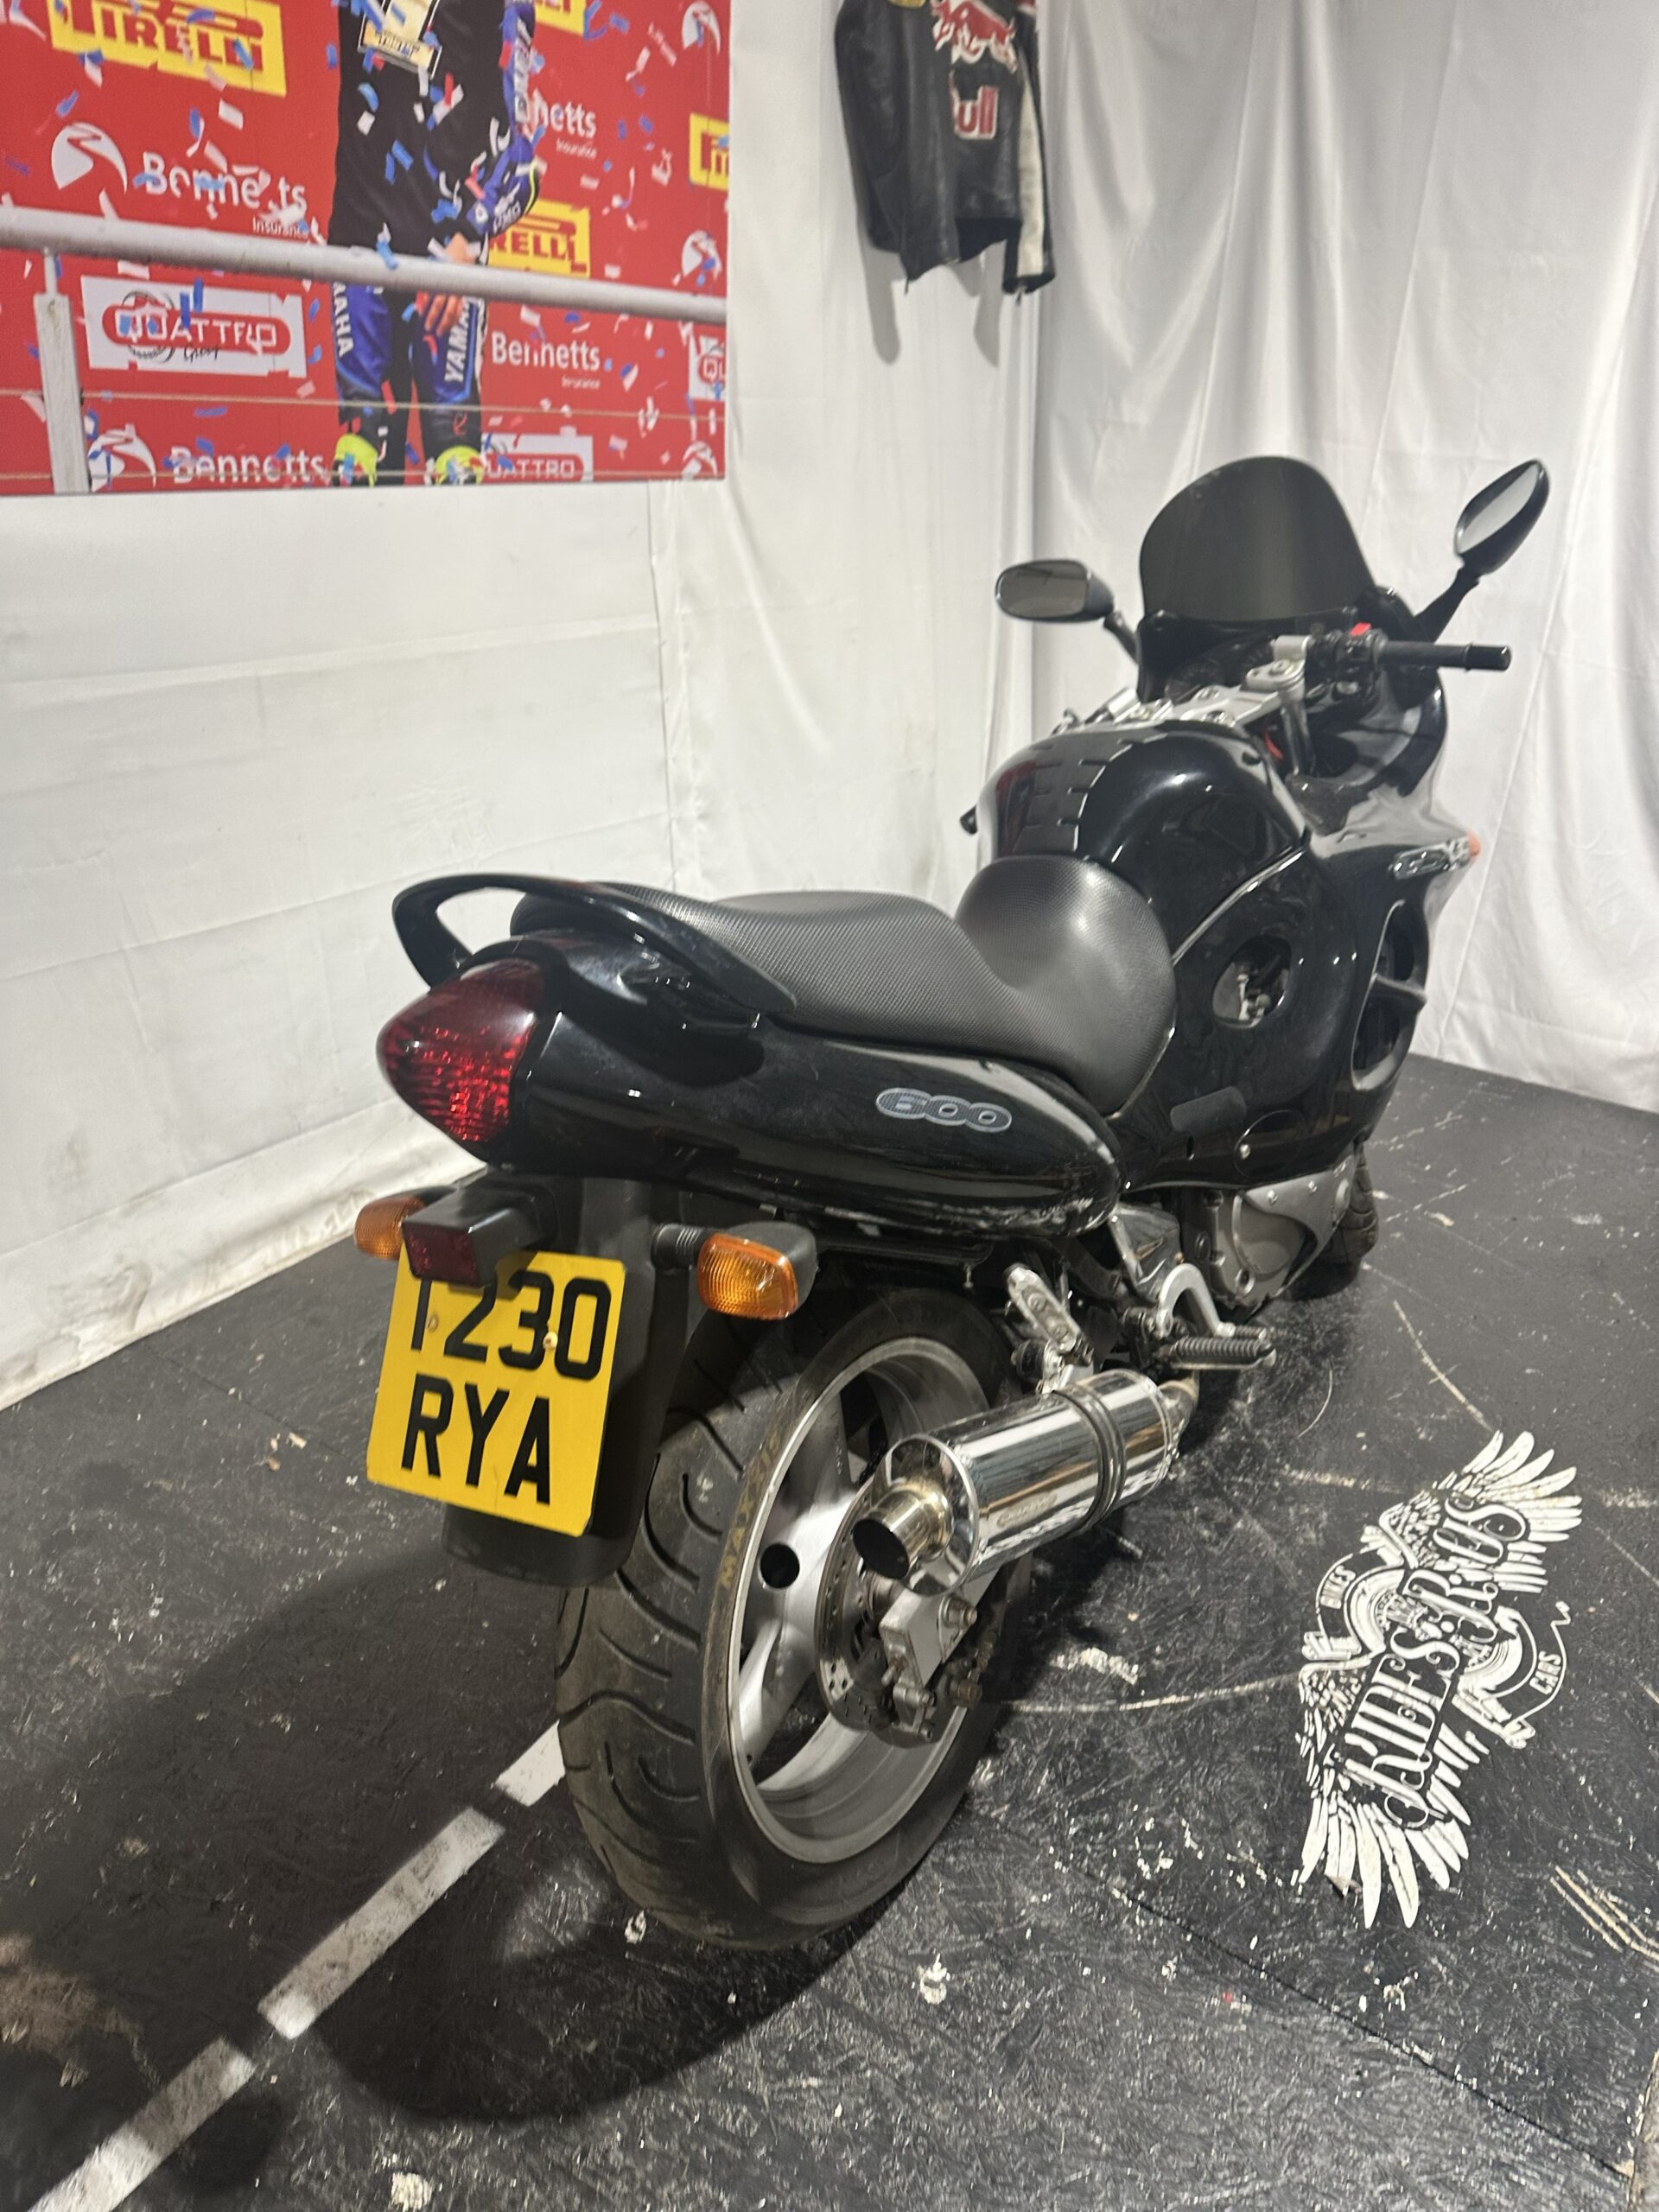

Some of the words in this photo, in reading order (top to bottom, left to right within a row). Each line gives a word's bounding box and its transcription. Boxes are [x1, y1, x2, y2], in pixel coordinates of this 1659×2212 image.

[953, 86, 1000, 139] ull
[143, 151, 307, 214] Bennets
[492, 330, 601, 372] Bennetts
[875, 1087, 1013, 1133] 600
[401, 1373, 550, 1506] RYA
[1529, 1649, 1562, 1695] CARS
[1344, 1627, 1460, 1830] RIDES
